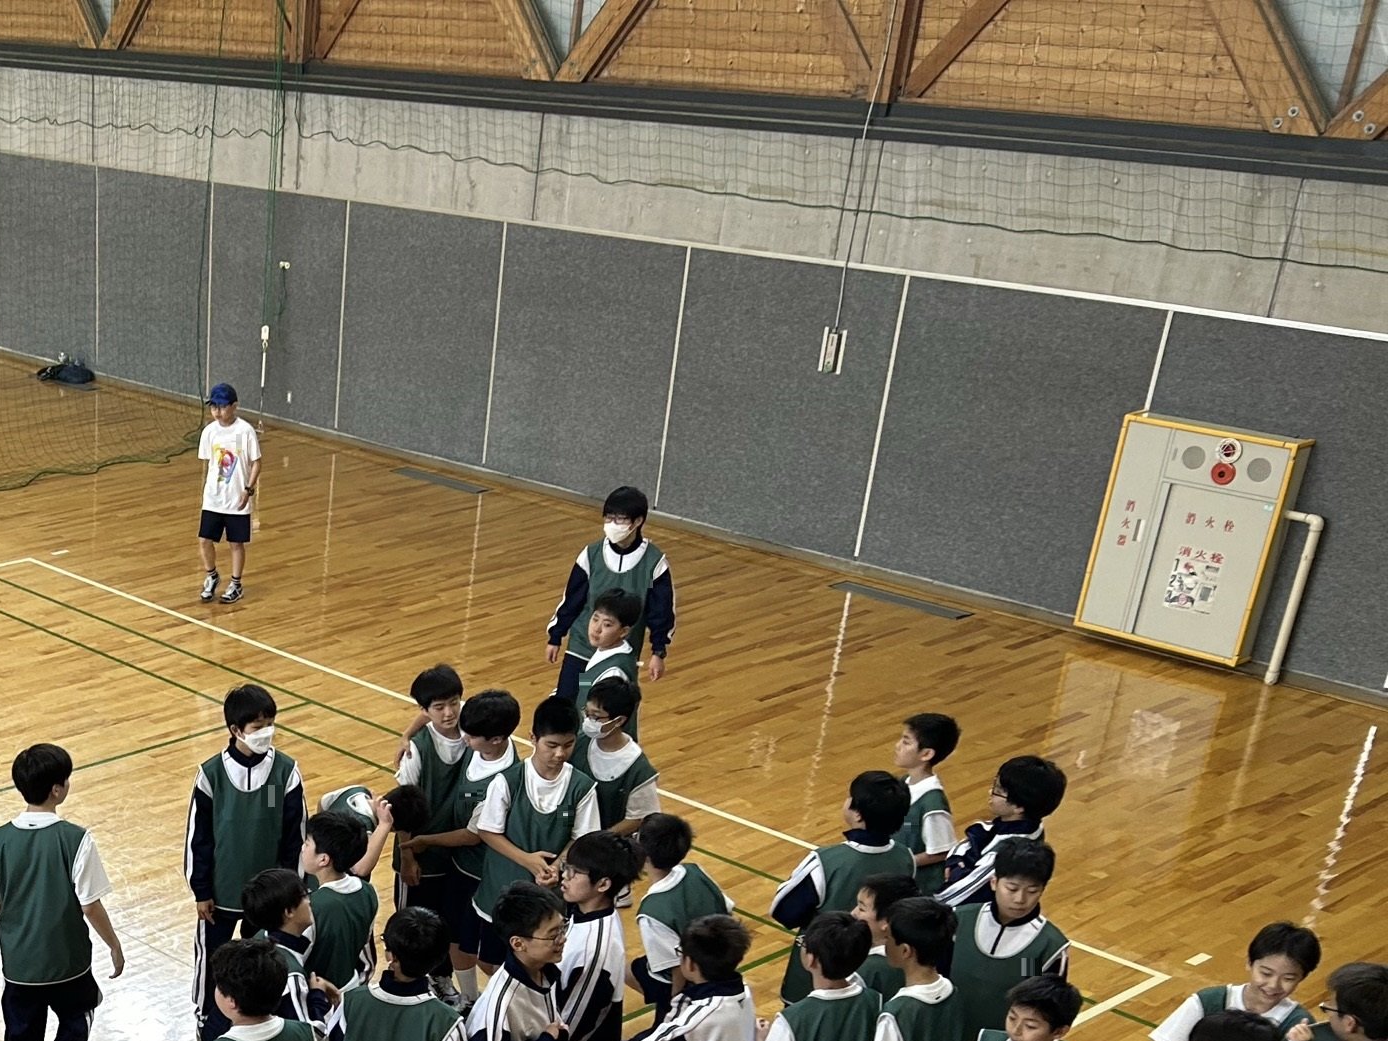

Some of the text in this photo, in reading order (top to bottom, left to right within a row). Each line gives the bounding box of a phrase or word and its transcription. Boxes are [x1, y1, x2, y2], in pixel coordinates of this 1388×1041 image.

[1116, 499, 1135, 546] 消火器
[1185, 512, 1235, 533] 消火栓
[1174, 558, 1180, 571] 1
[1178, 546, 1225, 565] 消火栓
[1169, 575, 1177, 587] 2
